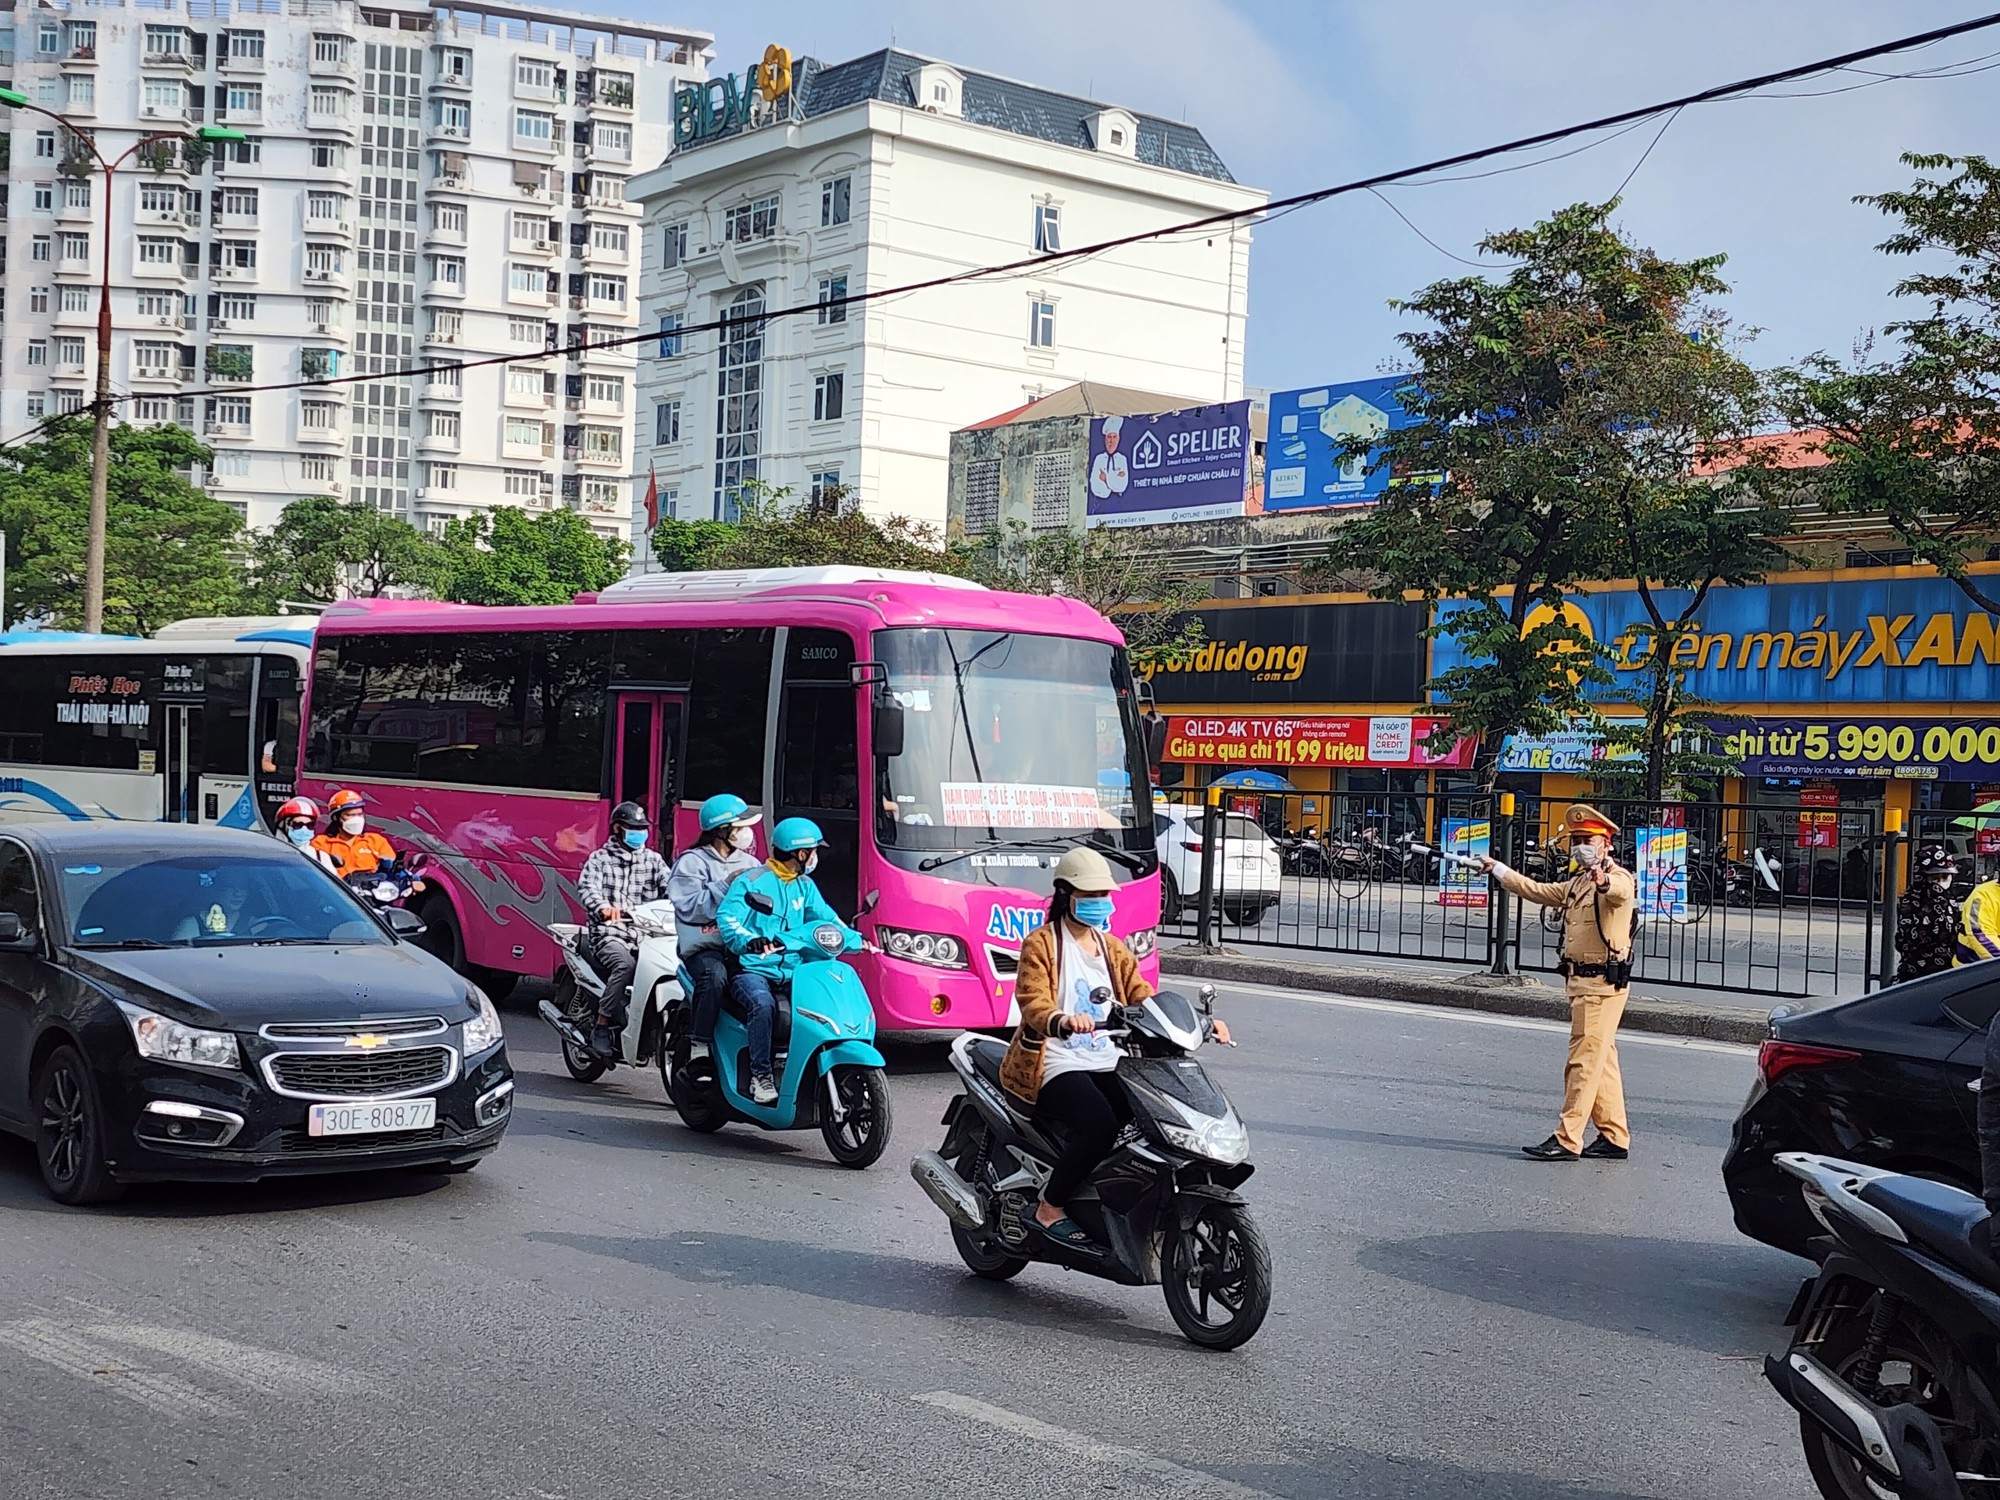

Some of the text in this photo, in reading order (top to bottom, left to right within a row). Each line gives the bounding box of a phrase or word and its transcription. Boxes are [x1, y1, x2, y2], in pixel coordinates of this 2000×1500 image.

[674, 63, 760, 145] BIDV
[1167, 425, 1242, 457] SPELIER
[1182, 457, 1201, 465] Kitchen
[1205, 454, 1219, 462] Enjoy
[1220, 452, 1242, 460] Cooking
[1159, 475, 1173, 485] NHÀ
[801, 647, 838, 660] SAMCO
[1737, 615, 1863, 680] máy
[68, 675, 109, 697] Phiệt
[110, 676, 141, 697] Học
[1251, 673, 1281, 682] .com
[57, 699, 80, 723] THÁI
[129, 700, 150, 730] NỘI
[1185, 720, 1226, 737] QLED
[1227, 721, 1248, 738] 4K
[1251, 721, 1273, 738] TV
[1386, 722, 1399, 731] GÓP
[1376, 741, 1404, 749] CREDIT
[1518, 736, 1524, 744] 2
[1557, 735, 1575, 744] lạnh
[1725, 725, 2000, 763] chỉ từ 5.990.000
[1170, 737, 1365, 765] Giá rẻ quá chỉ 11,99 triệu
[1504, 748, 1529, 769] GIÁ
[1529, 744, 1552, 769] RẺ
[1777, 765, 1798, 775] dưỡng
[1799, 766, 1813, 775] máy
[1814, 767, 1825, 776] lọc
[1896, 766, 1915, 774] 1800
[1917, 766, 1938, 774] 1783
[944, 789, 963, 804] NAM
[964, 789, 983, 807] ĐỊNH
[945, 806, 967, 826] HÀNH
[326, 1103, 432, 1131] 30E-808.77
[1131, 1160, 1158, 1175] HONDA
